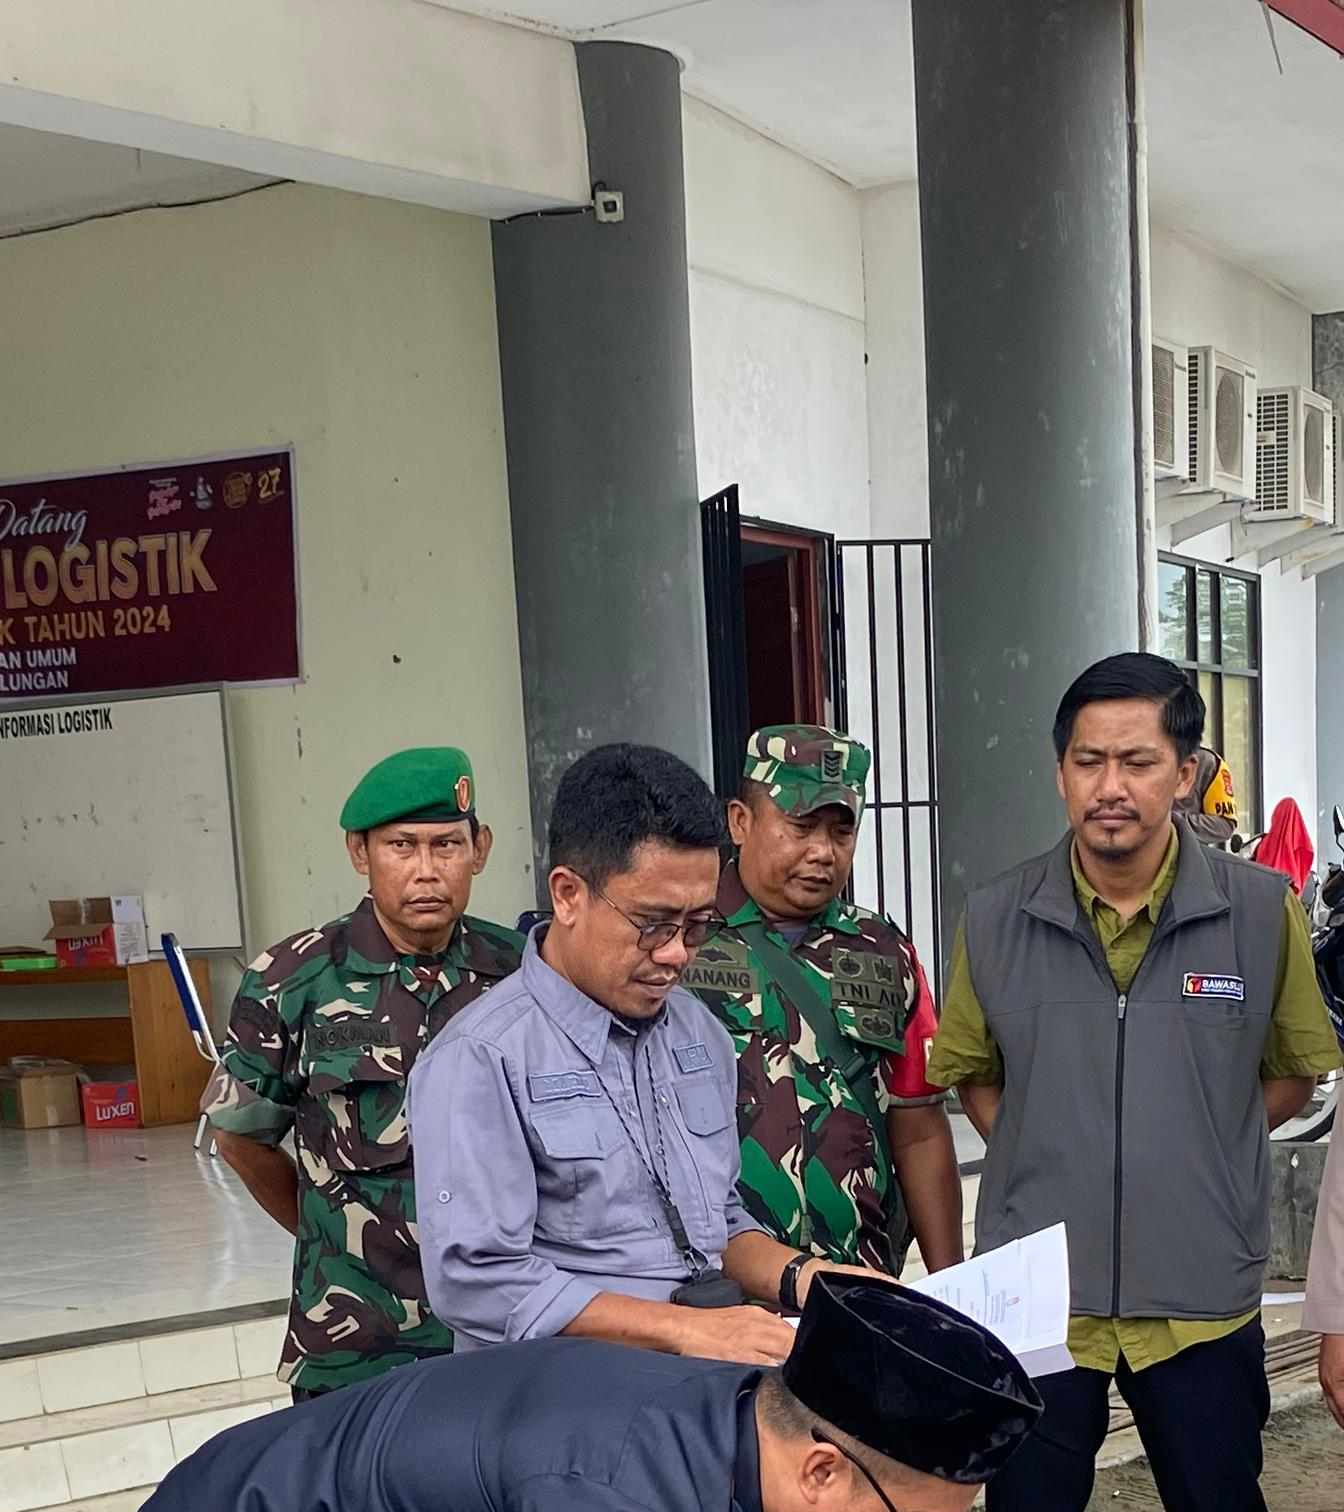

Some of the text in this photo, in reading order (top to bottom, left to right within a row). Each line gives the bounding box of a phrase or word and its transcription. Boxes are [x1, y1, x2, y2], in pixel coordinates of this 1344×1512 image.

[1, 528, 217, 609] LOGISTIK
[24, 610, 106, 643] TAHUN
[113, 604, 171, 636] 2024
[25, 647, 77, 668] UMUM
[58, 708, 113, 734] LOGISTIK
[680, 968, 750, 988] NANANG
[840, 983, 870, 1001] TNI
